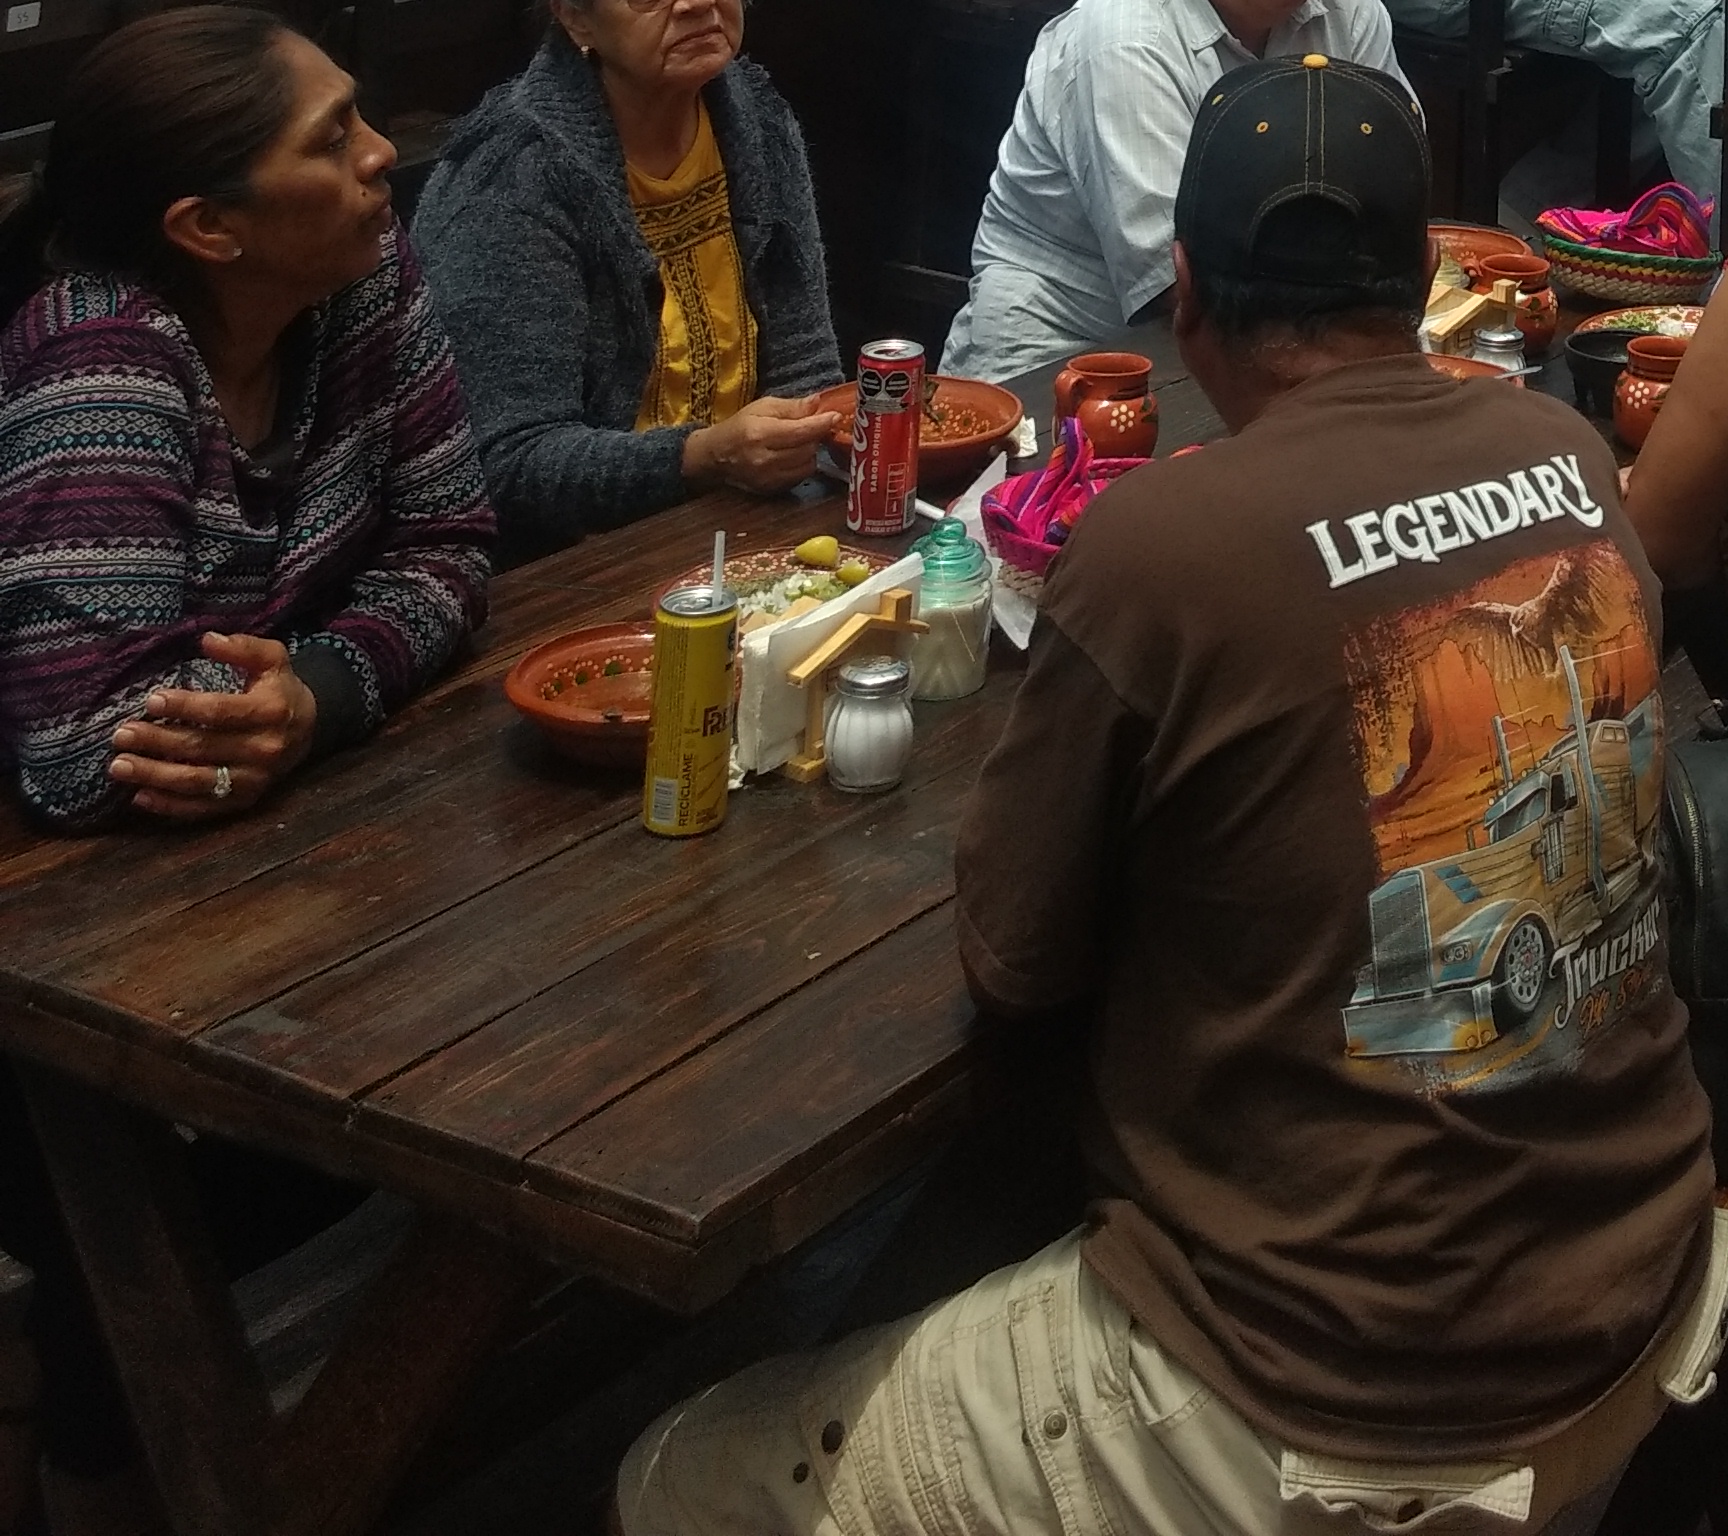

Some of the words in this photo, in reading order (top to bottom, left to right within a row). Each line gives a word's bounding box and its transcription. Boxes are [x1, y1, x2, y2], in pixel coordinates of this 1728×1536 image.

[872, 413, 882, 456] ORIGINA
[870, 459, 879, 493] SABOR
[1306, 453, 1605, 590] LEGENDARY
